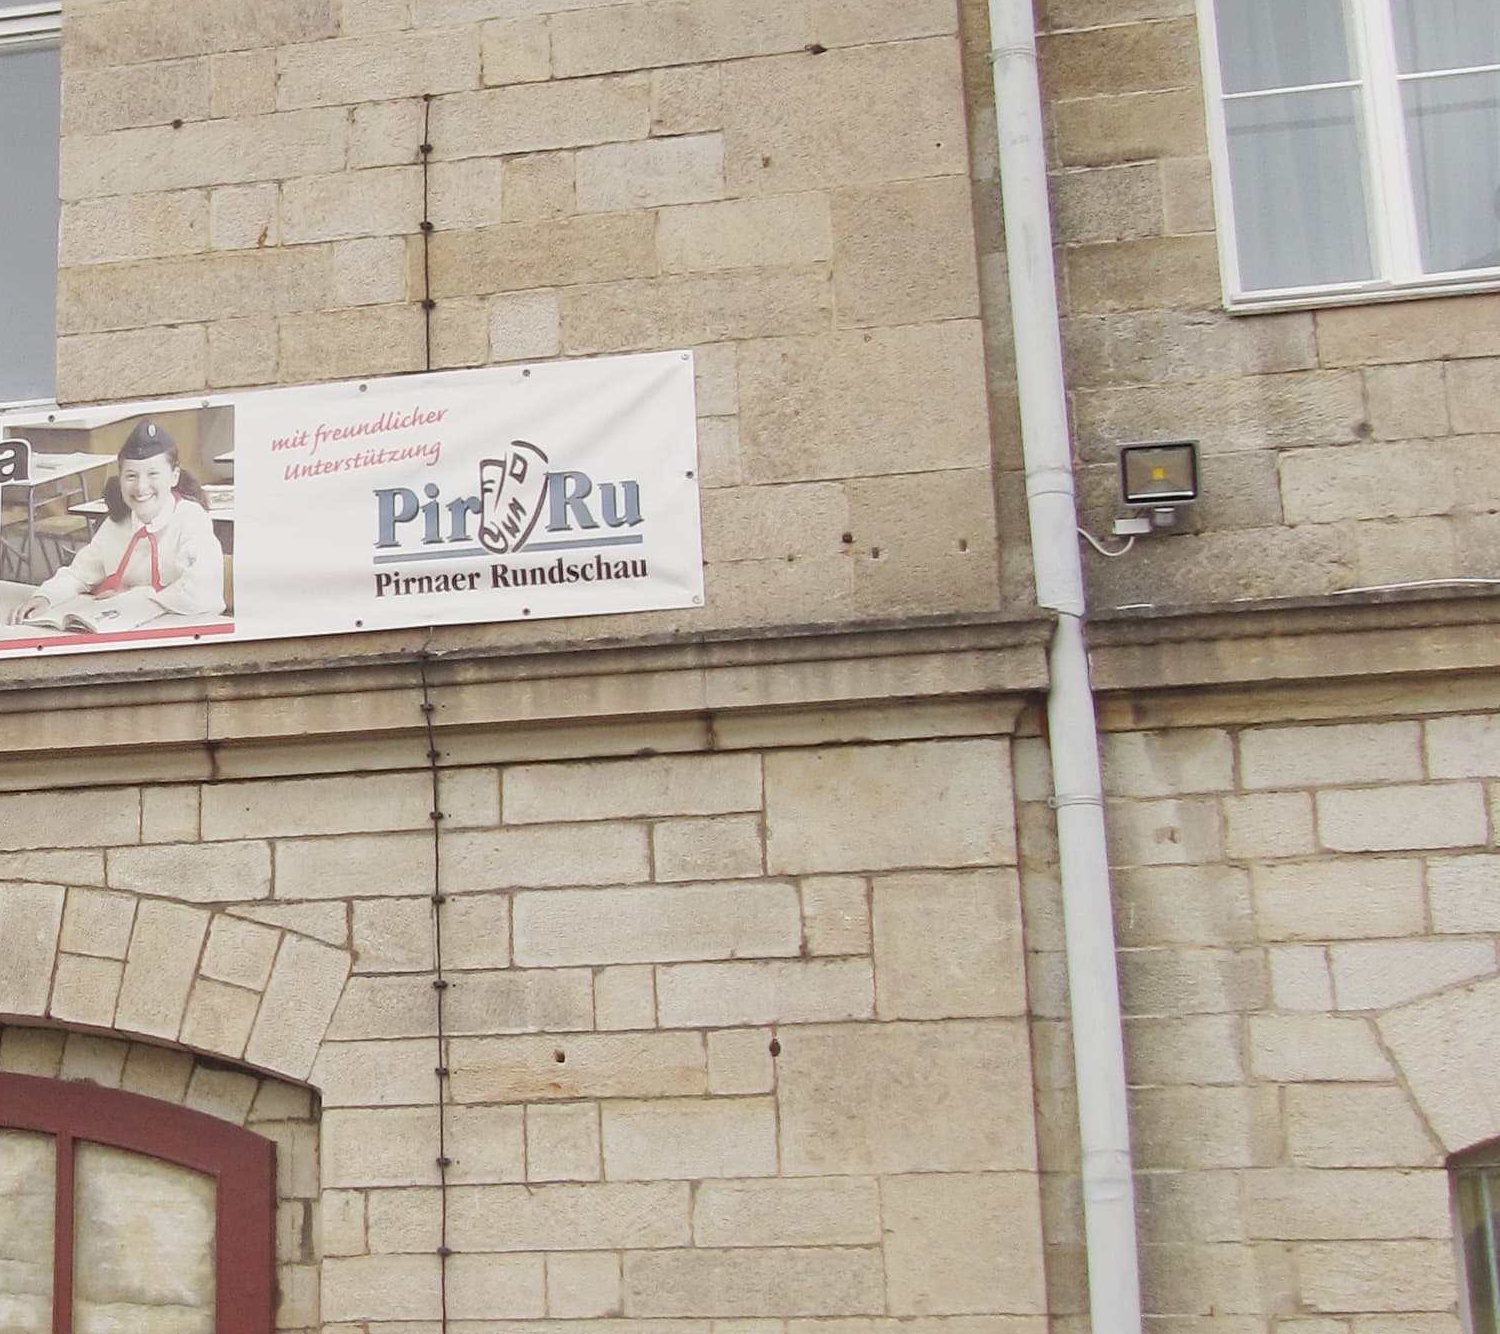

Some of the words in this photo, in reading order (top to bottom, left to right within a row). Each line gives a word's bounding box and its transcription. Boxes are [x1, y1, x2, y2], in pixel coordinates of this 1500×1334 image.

[271, 429, 310, 452] mit
[310, 405, 449, 455] freundlicher
[284, 441, 441, 481] Unterstützung
[374, 570, 481, 598] Pirnaer
[490, 554, 648, 589] Rundschau
